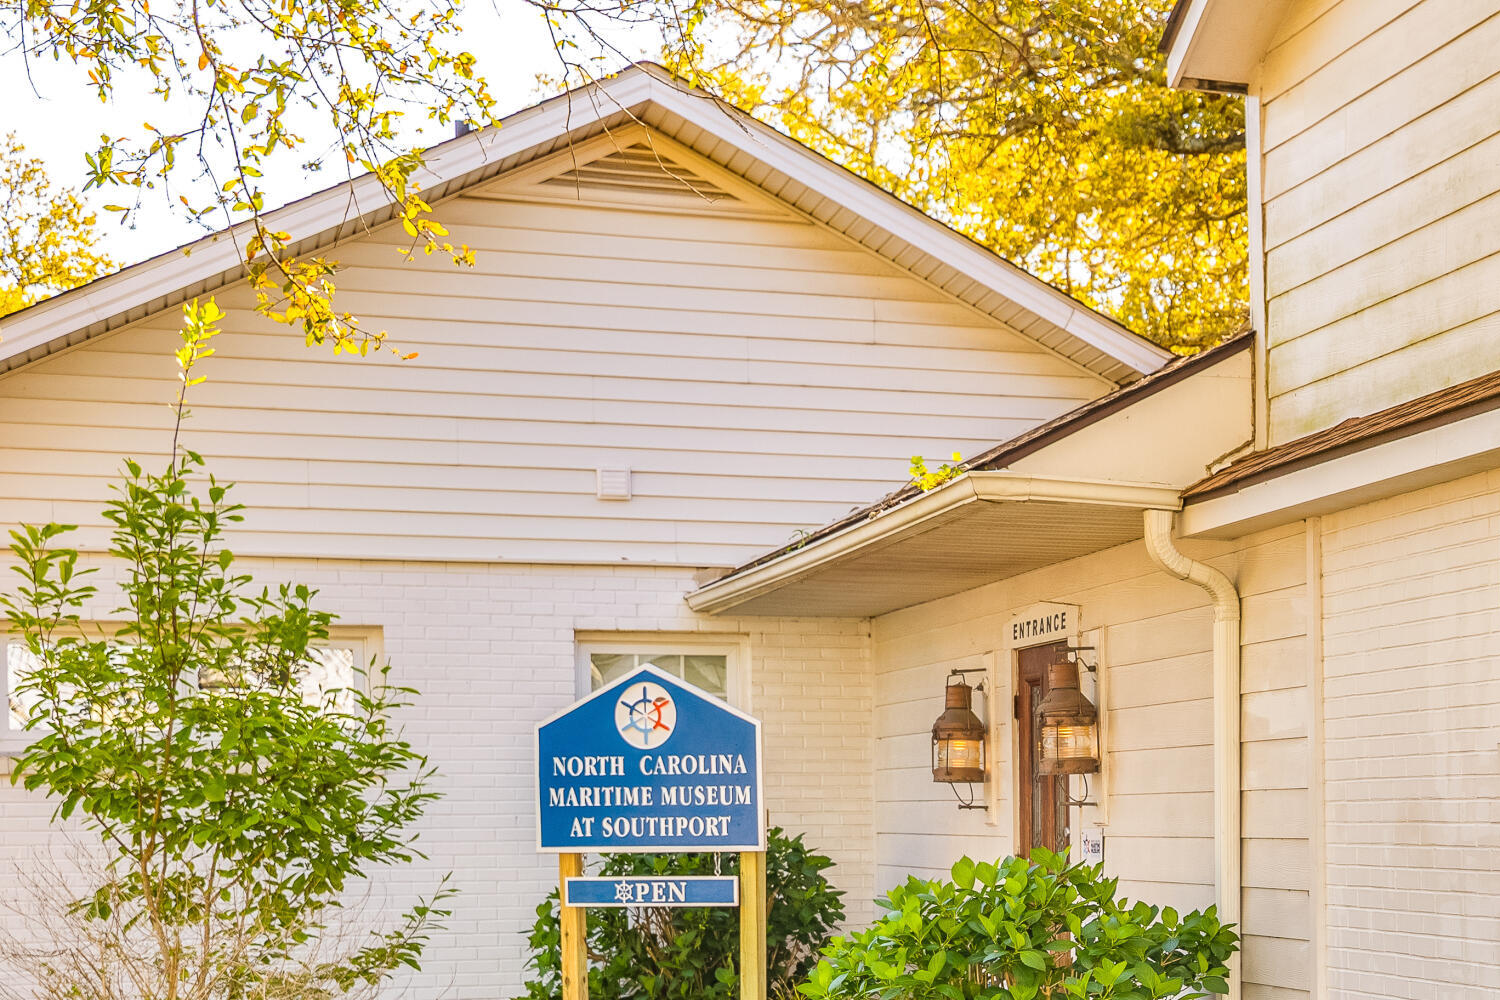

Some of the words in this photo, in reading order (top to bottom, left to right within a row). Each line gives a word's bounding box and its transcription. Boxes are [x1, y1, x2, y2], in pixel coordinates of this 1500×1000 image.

[1013, 612, 1067, 640] ENTRANCE
[553, 756, 625, 777] NORTH
[639, 754, 748, 776] CAROLINA
[549, 786, 653, 807] MARITIME
[661, 785, 752, 806] MUSEUM
[570, 817, 595, 837] AT
[602, 815, 731, 838] SOUTHPORT
